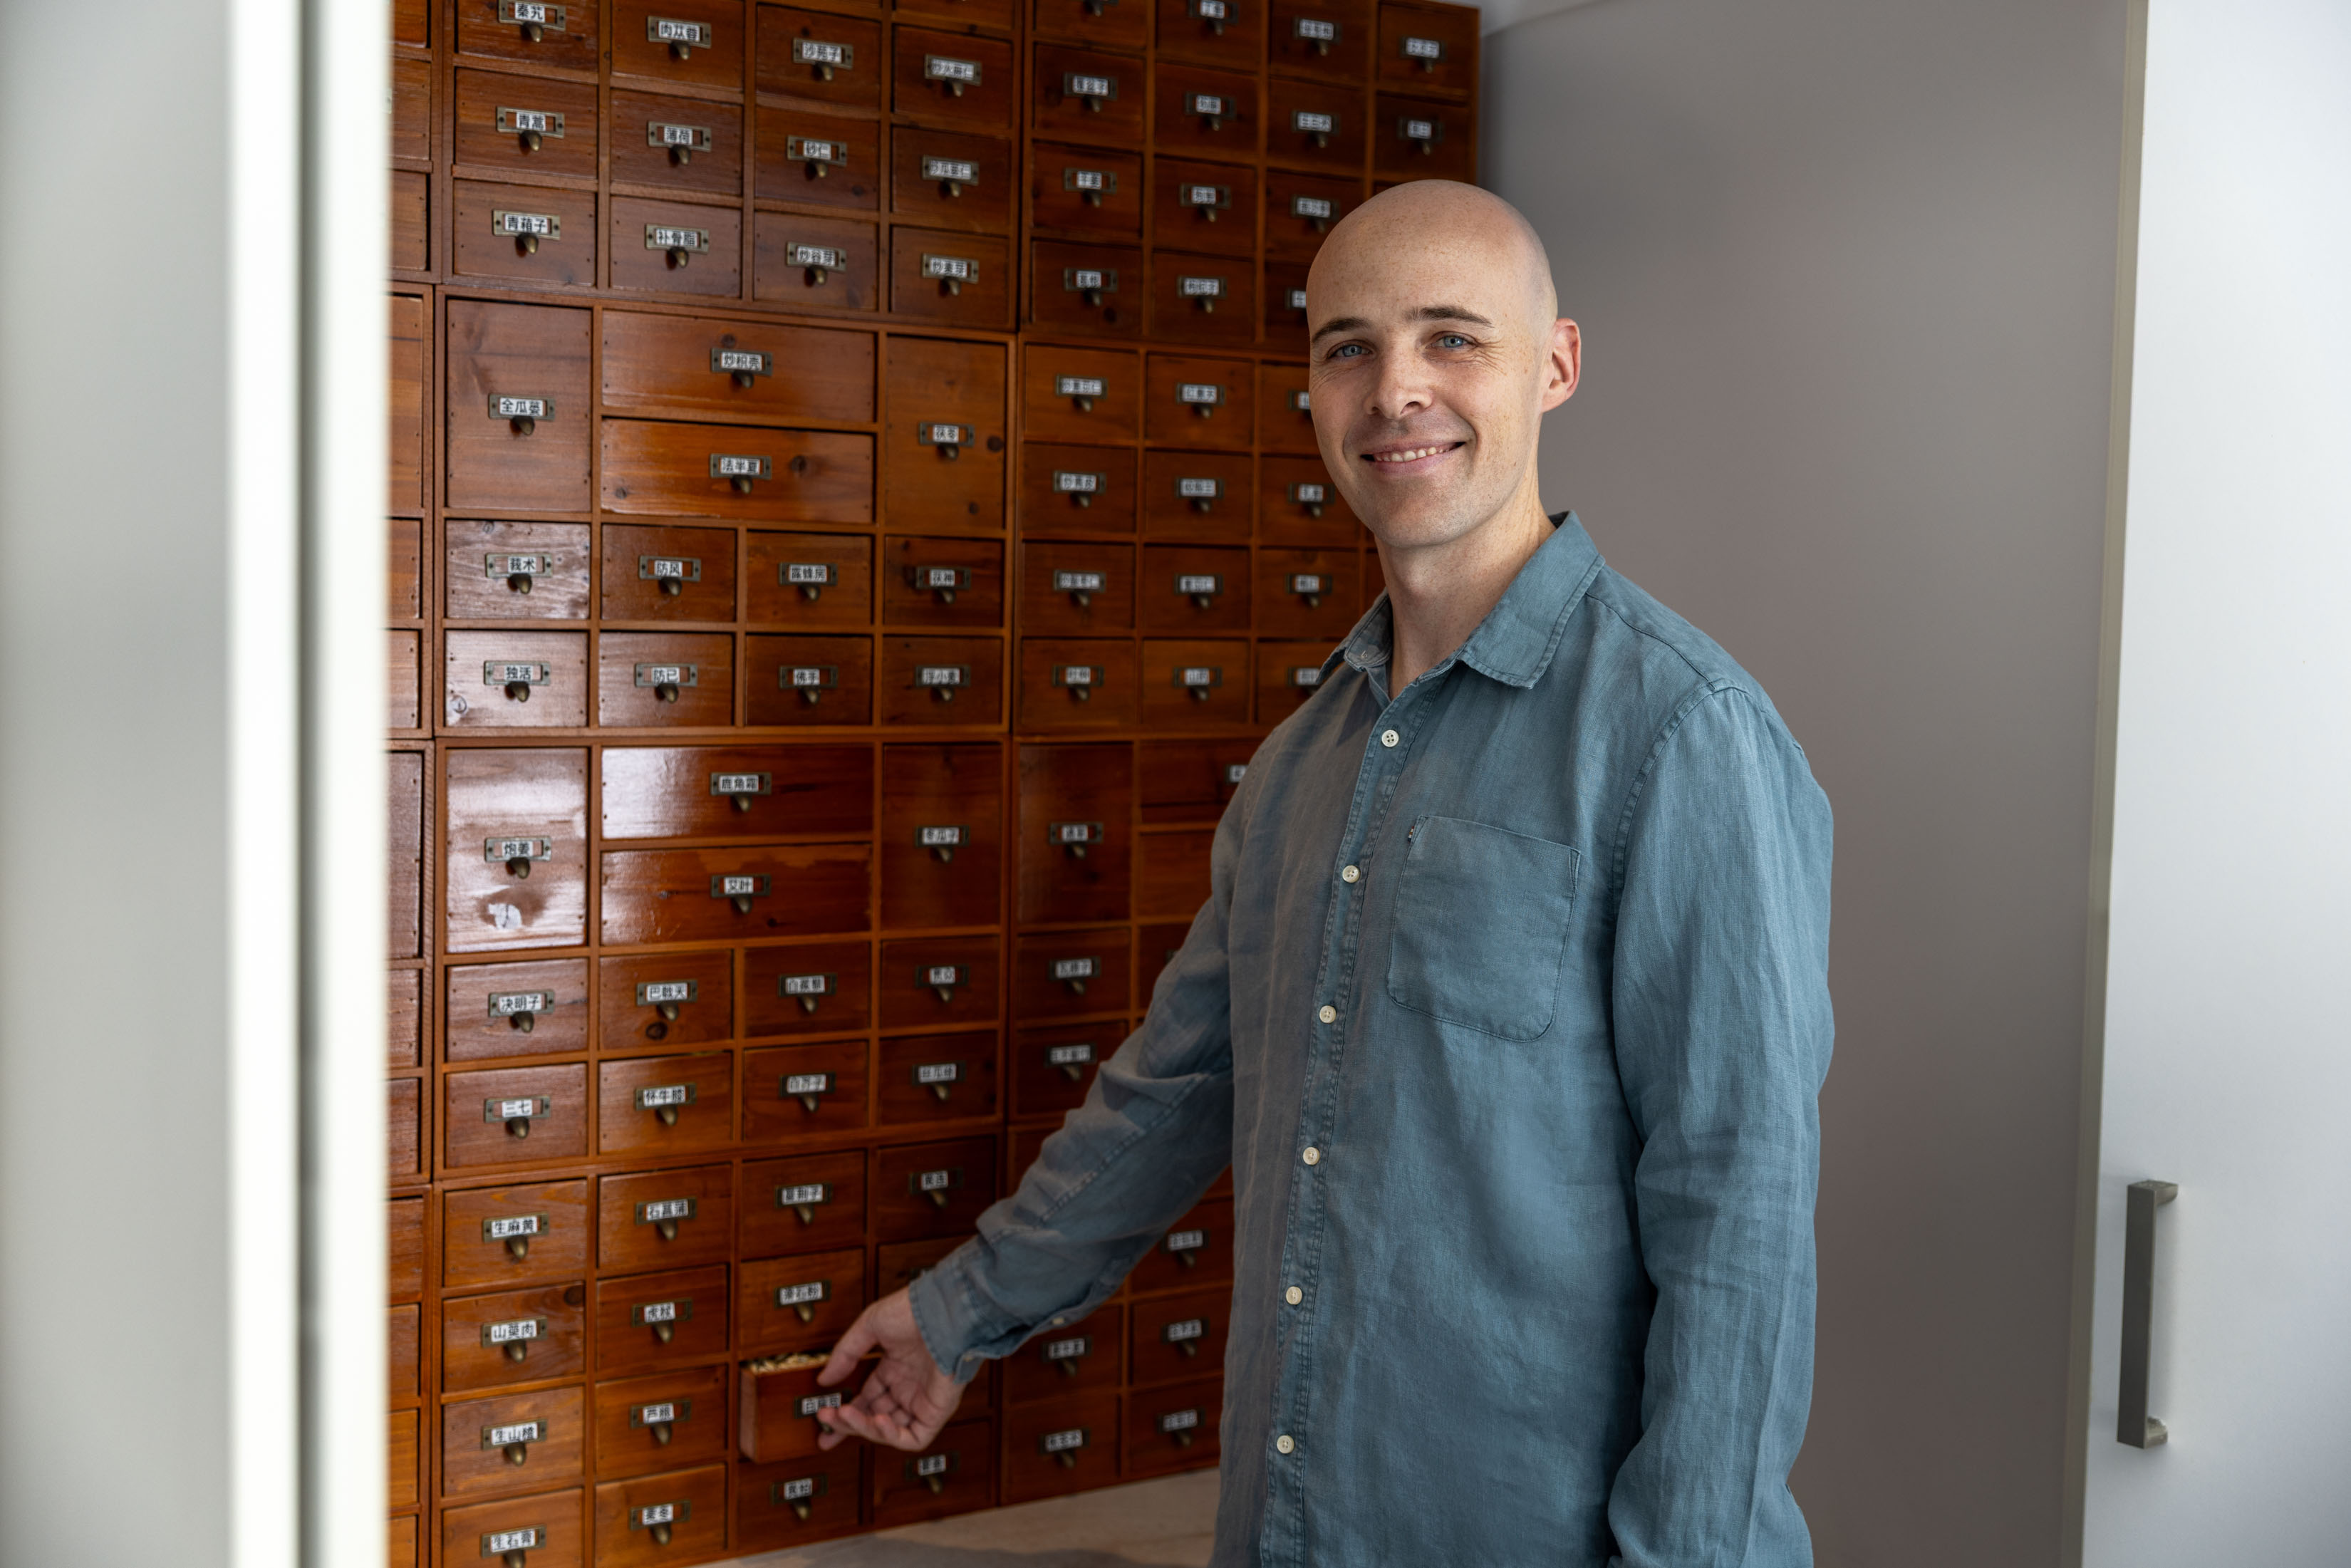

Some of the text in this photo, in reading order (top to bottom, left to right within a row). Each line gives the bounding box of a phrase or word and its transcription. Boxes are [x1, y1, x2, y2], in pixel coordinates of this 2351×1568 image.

[516, 4, 544, 22] 秦艽
[660, 22, 699, 41] 肉苁蓉
[803, 43, 840, 63] 沙苑子
[517, 112, 544, 132] 青蒿
[665, 125, 692, 145] 薄荷
[804, 142, 830, 160] 砂仁
[656, 229, 697, 247] 补骨脂
[797, 247, 834, 266] 炒谷芽
[930, 259, 966, 277] 炒麦芽
[722, 353, 761, 370] 炒枳壳
[500, 398, 543, 417] 全瓜蒌
[934, 426, 957, 442] 茯苓
[722, 458, 759, 474] 法半夏
[509, 556, 536, 573] 莪术
[655, 561, 681, 576] 防风
[790, 566, 826, 582] 露蜂房
[931, 571, 954, 586] 茯神
[505, 665, 532, 681] 独活
[794, 670, 819, 685] 佛手
[923, 669, 959, 684] 浮小麦
[720, 776, 757, 792] 鹿角霜
[924, 829, 958, 843] 冬瓜子
[502, 841, 532, 858] 炮姜
[725, 878, 752, 893] 艾叶
[648, 984, 686, 1002] 巴戟天
[499, 994, 541, 1013] 决明子
[644, 1087, 685, 1106] 怀牛膝
[502, 1100, 532, 1118] 三七
[648, 1201, 687, 1220] 石菖蒲
[492, 1217, 536, 1237] 生麻黄
[645, 1304, 674, 1322] 虎杖
[492, 1321, 535, 1342] 山萸肉
[645, 1405, 673, 1423] 芦根
[492, 1423, 536, 1445] 生山楂
[492, 1530, 534, 1552] 生石膏
